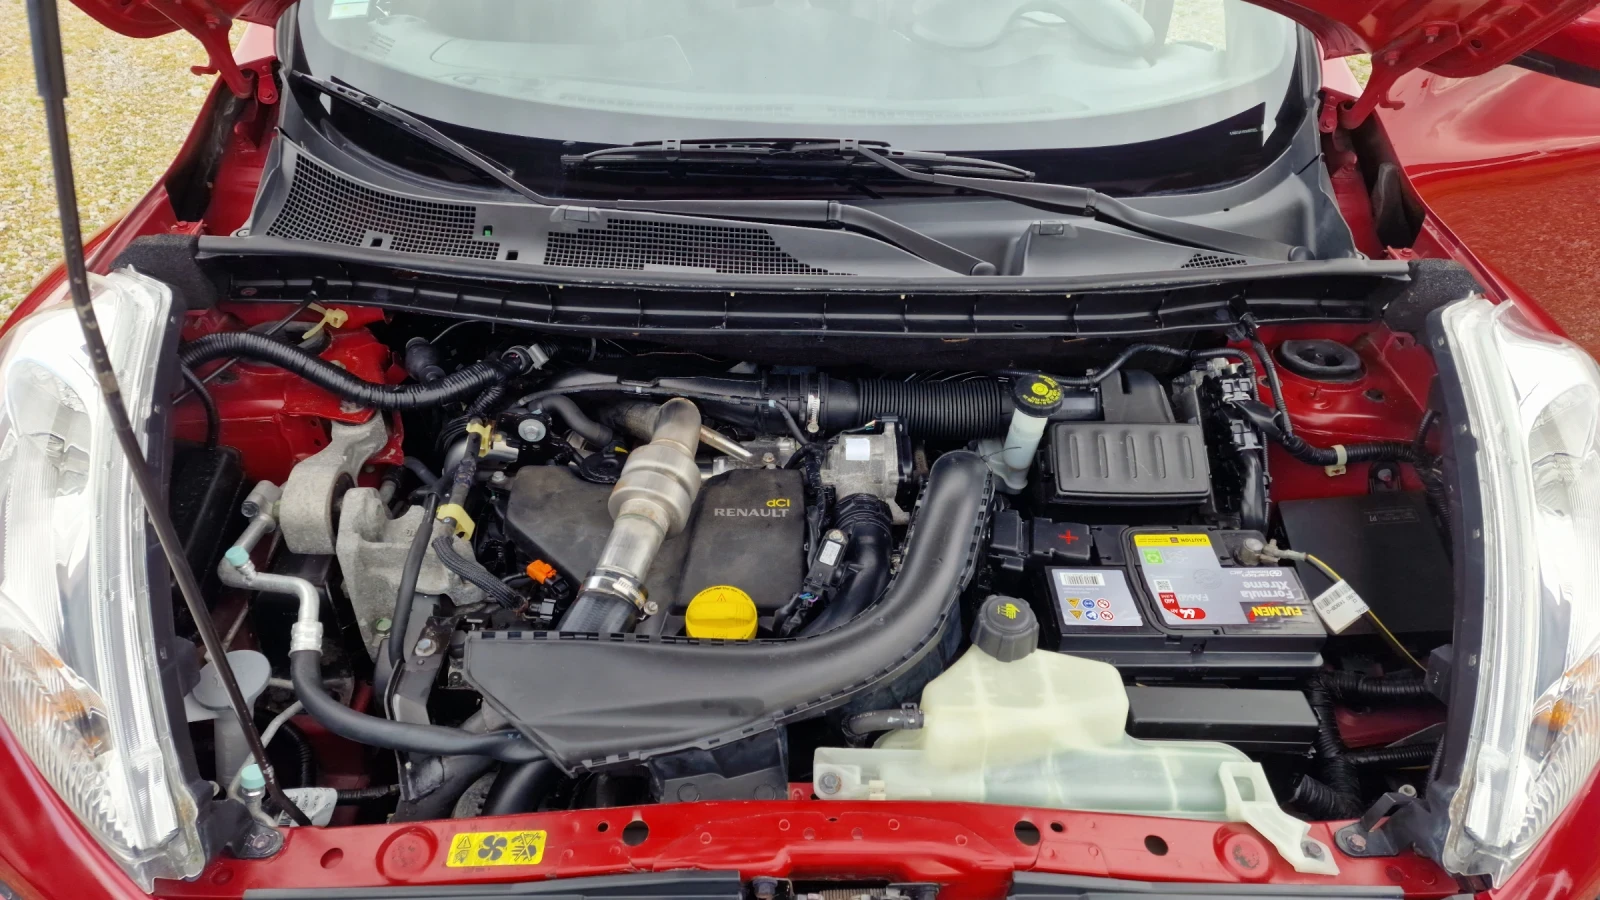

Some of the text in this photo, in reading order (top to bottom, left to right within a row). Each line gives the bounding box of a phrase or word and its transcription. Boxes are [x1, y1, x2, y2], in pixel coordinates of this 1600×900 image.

[714, 508, 790, 517] RENAULT
[1242, 581, 1291, 590] Xtreme
[1240, 590, 1295, 600] Formula
[1179, 608, 1196, 619] 64
[1251, 606, 1303, 617] FULMEN
